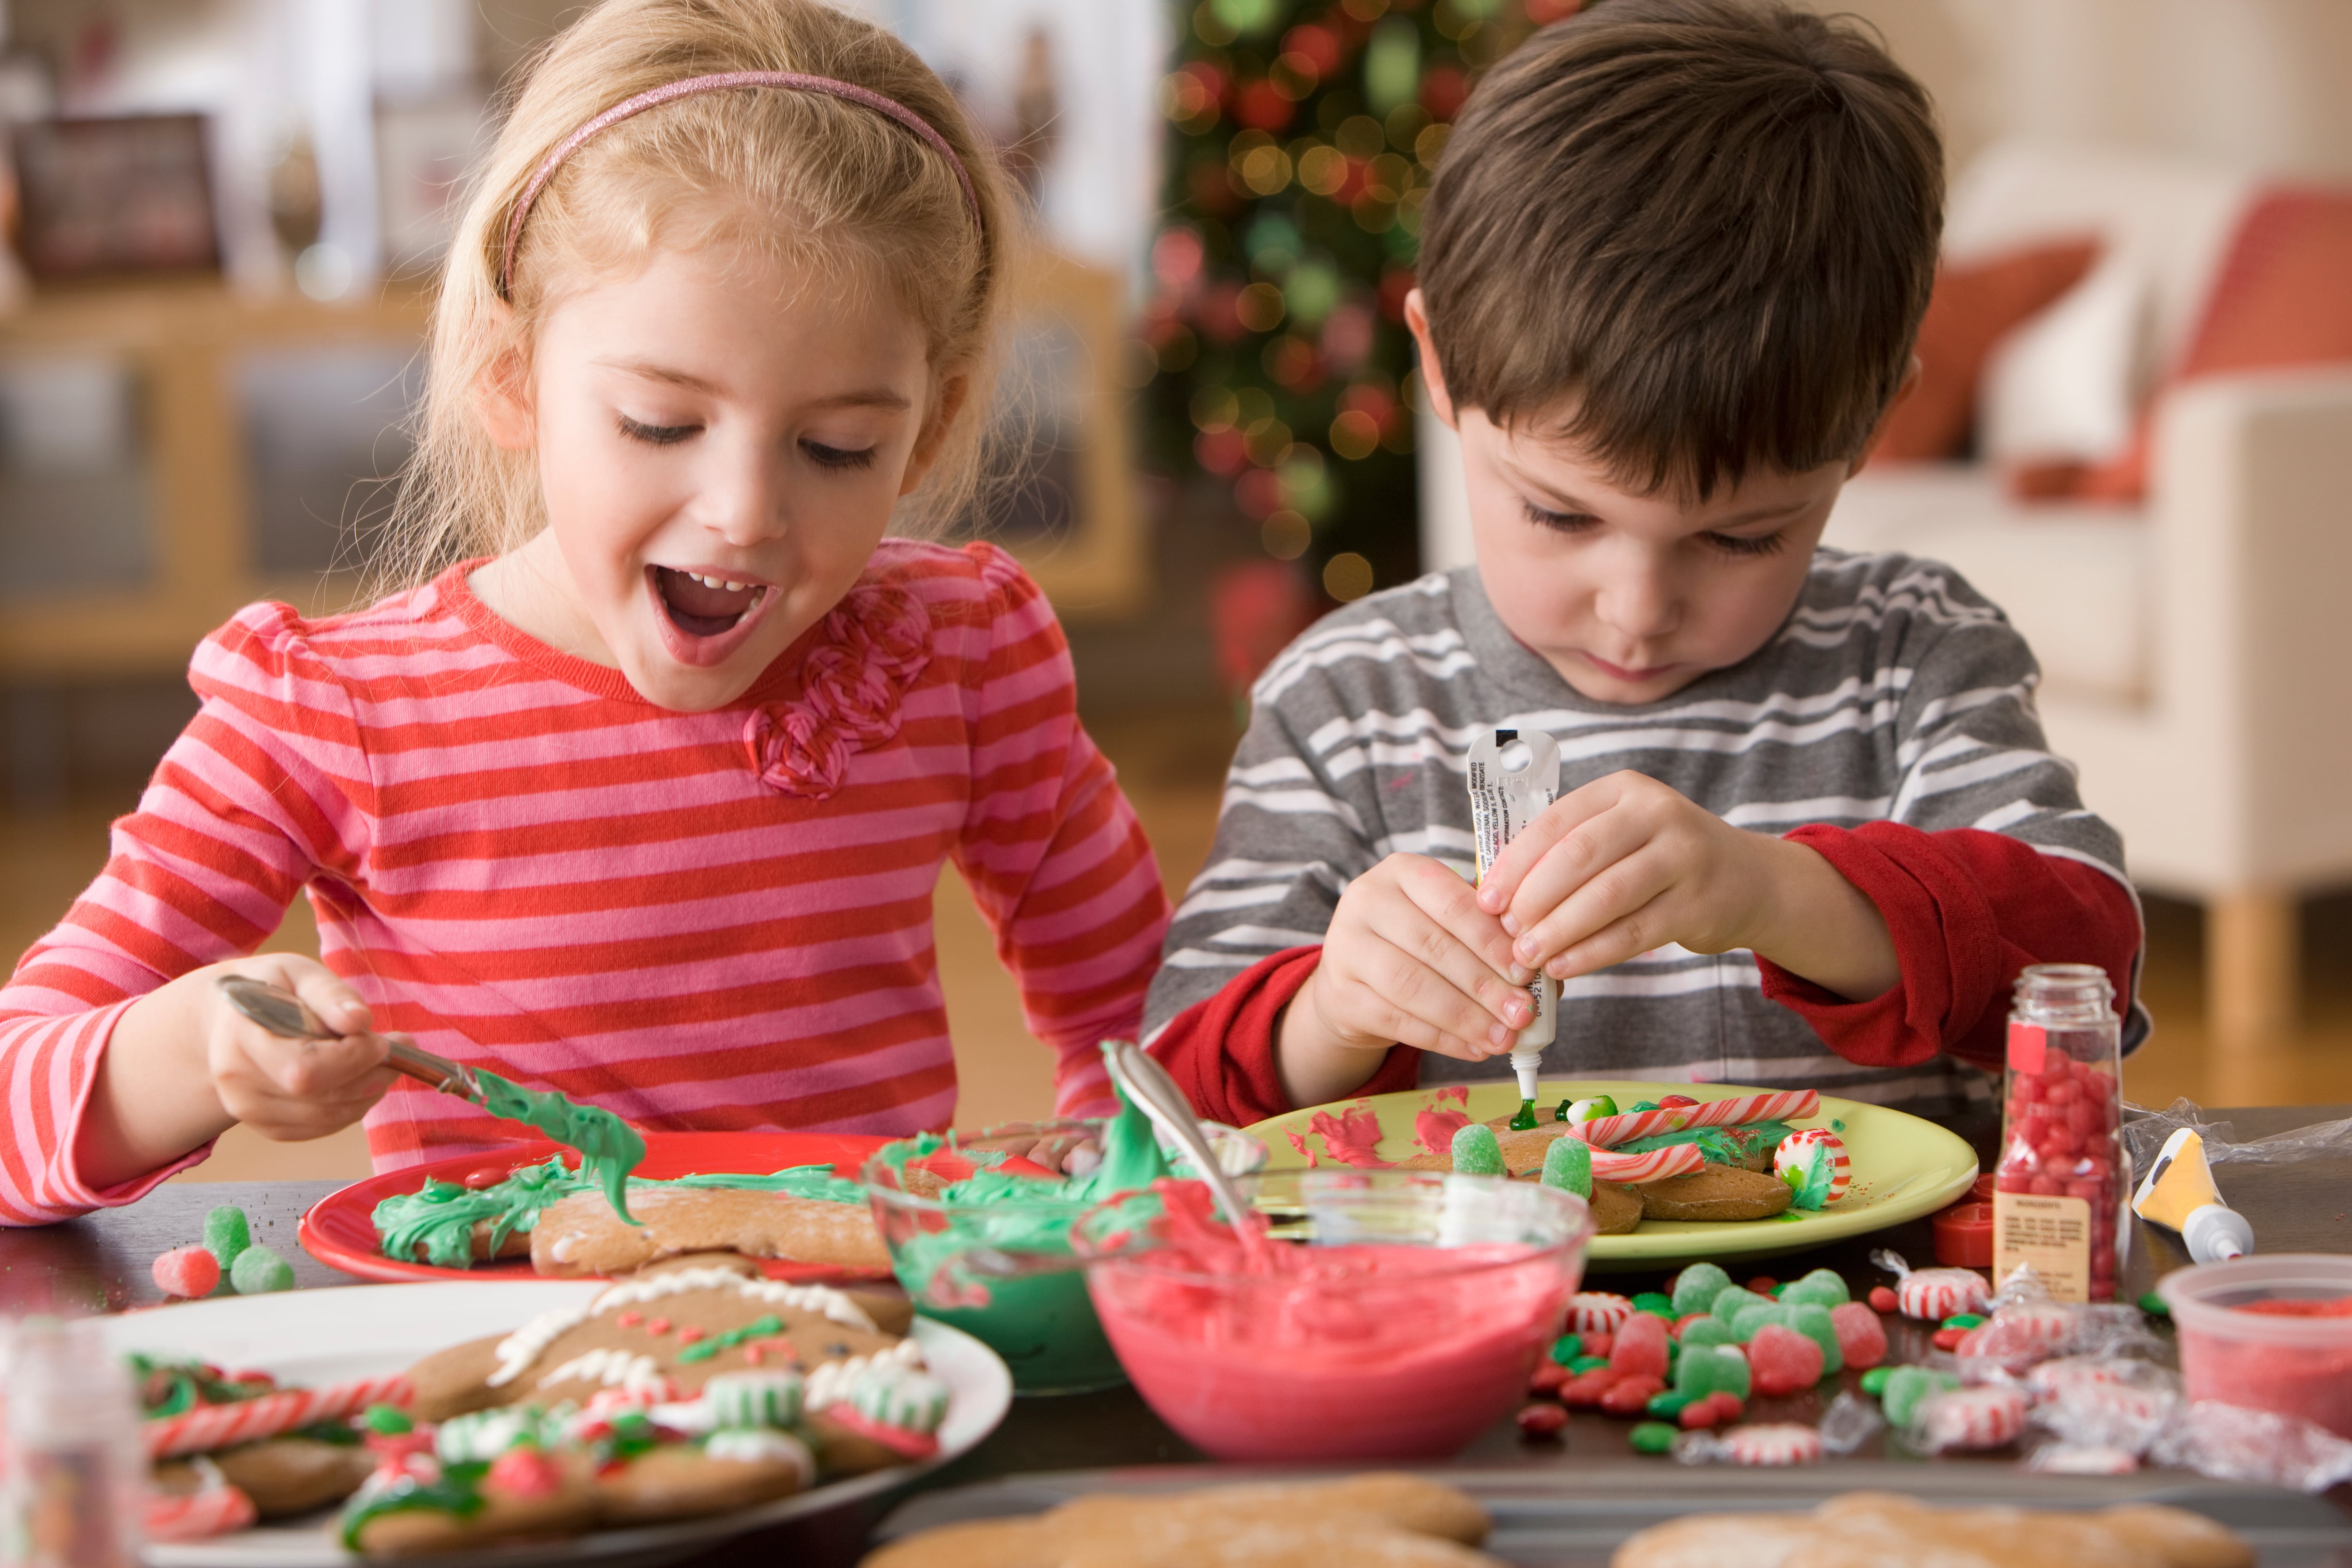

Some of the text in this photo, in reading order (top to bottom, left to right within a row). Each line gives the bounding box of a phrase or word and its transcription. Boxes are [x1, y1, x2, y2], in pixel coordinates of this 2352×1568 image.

[1480, 792, 1489, 811] SODIUM
[1498, 786, 1508, 808] CONTACT:
[1484, 812, 1492, 855] CARRAGEENAN,
